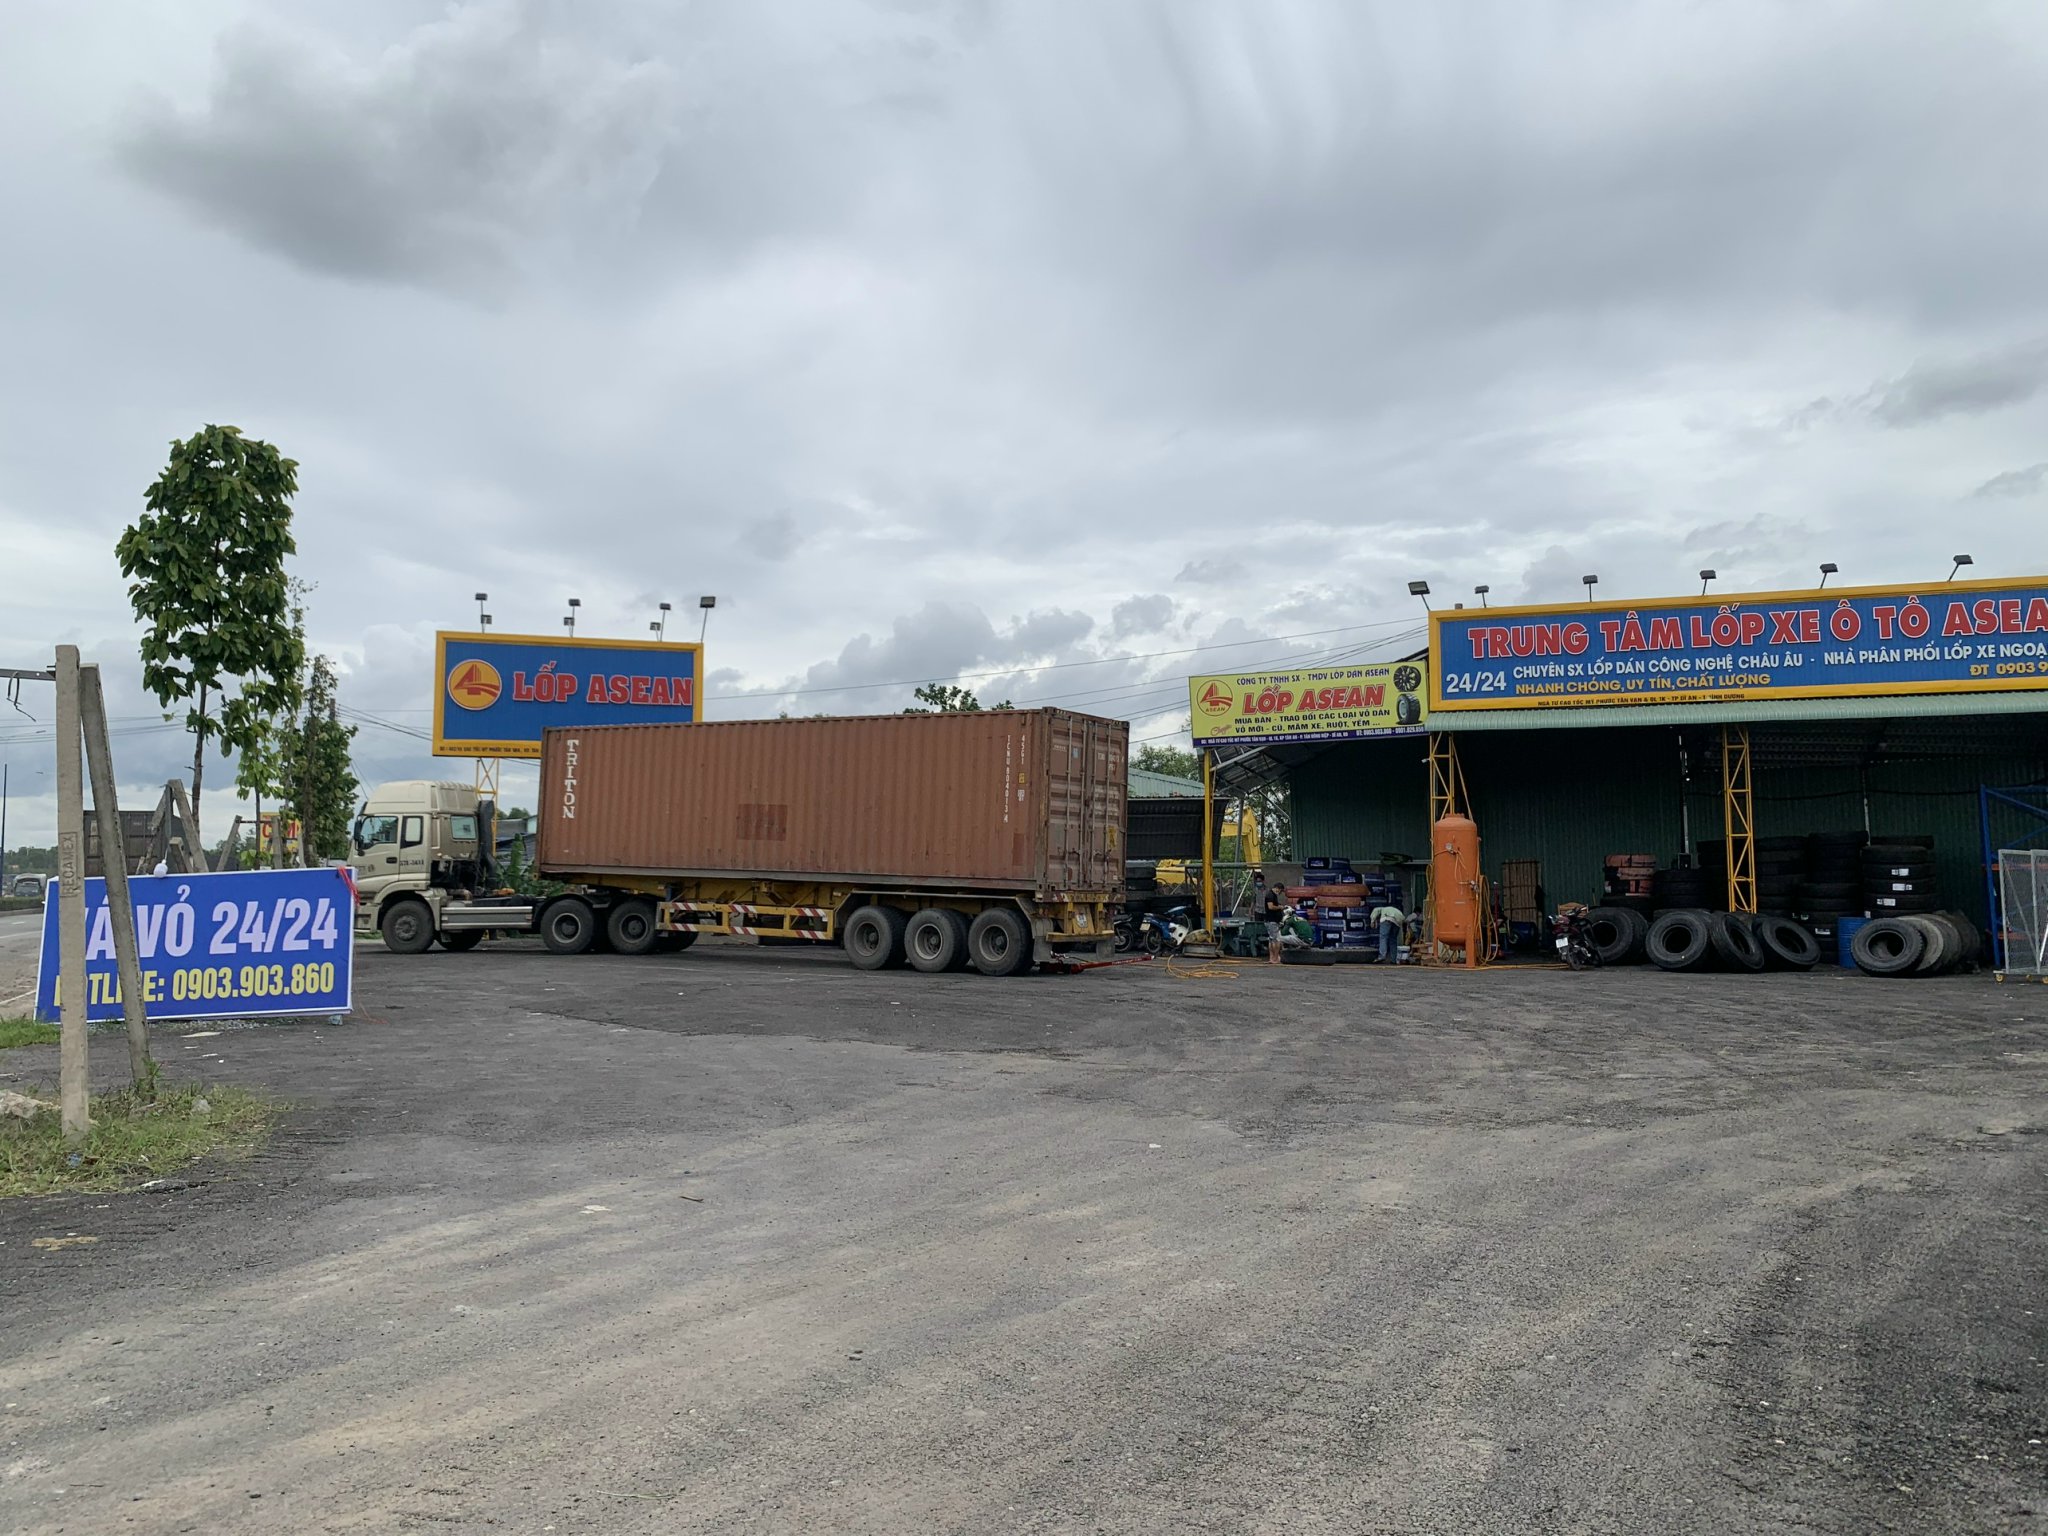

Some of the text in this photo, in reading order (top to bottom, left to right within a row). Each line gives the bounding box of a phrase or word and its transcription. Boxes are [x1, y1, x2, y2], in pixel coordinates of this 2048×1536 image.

[1468, 622, 1589, 659] TRUNG
[1600, 611, 1684, 652] TÂM
[1690, 603, 1765, 648] LỐP
[1769, 610, 1821, 644] XE
[1830, 599, 1861, 641] Ô
[1873, 595, 1930, 639] TÔ
[1258, 677, 1267, 685] TY
[1270, 675, 1289, 684] TNHH
[1292, 675, 1300, 683] SX
[1307, 673, 1328, 681] TMDV
[1365, 667, 1390, 678] ASEAN
[1513, 662, 1564, 679] CHUYÊN
[1567, 663, 1584, 677] SX
[1588, 656, 1613, 675] LỐP
[1616, 658, 1645, 674] DÁN
[1648, 656, 1691, 673] CÔNG
[1695, 654, 1733, 672] NGHỆ
[1738, 652, 1779, 669] CHÂU
[1783, 651, 1803, 667] ÂU
[1824, 647, 1856, 665] NHÀ
[1859, 646, 1900, 663] PHÂN
[1904, 640, 1940, 661] PHỐI
[1944, 639, 1972, 660] LỐP
[1977, 644, 1996, 658] XE
[1970, 664, 1989, 676] ĐT
[1996, 661, 2036, 674] 0903
[513, 660, 693, 705] LỐP ASEAN
[1242, 683, 1386, 715] LỐP ASEAN
[1446, 671, 1507, 693] 24/24
[1515, 672, 1771, 695] NHANH CHÓNG, UY TÍN, CHẤT LƯỢNG
[1234, 717, 1252, 725] MUA
[1279, 714, 1300, 722] TRAO
[1318, 711, 1335, 720] CÁC
[562, 739, 579, 818] TRITON
[85, 884, 338, 960] Á VỎ 24/24
[172, 962, 334, 1001] 0903.903.860
